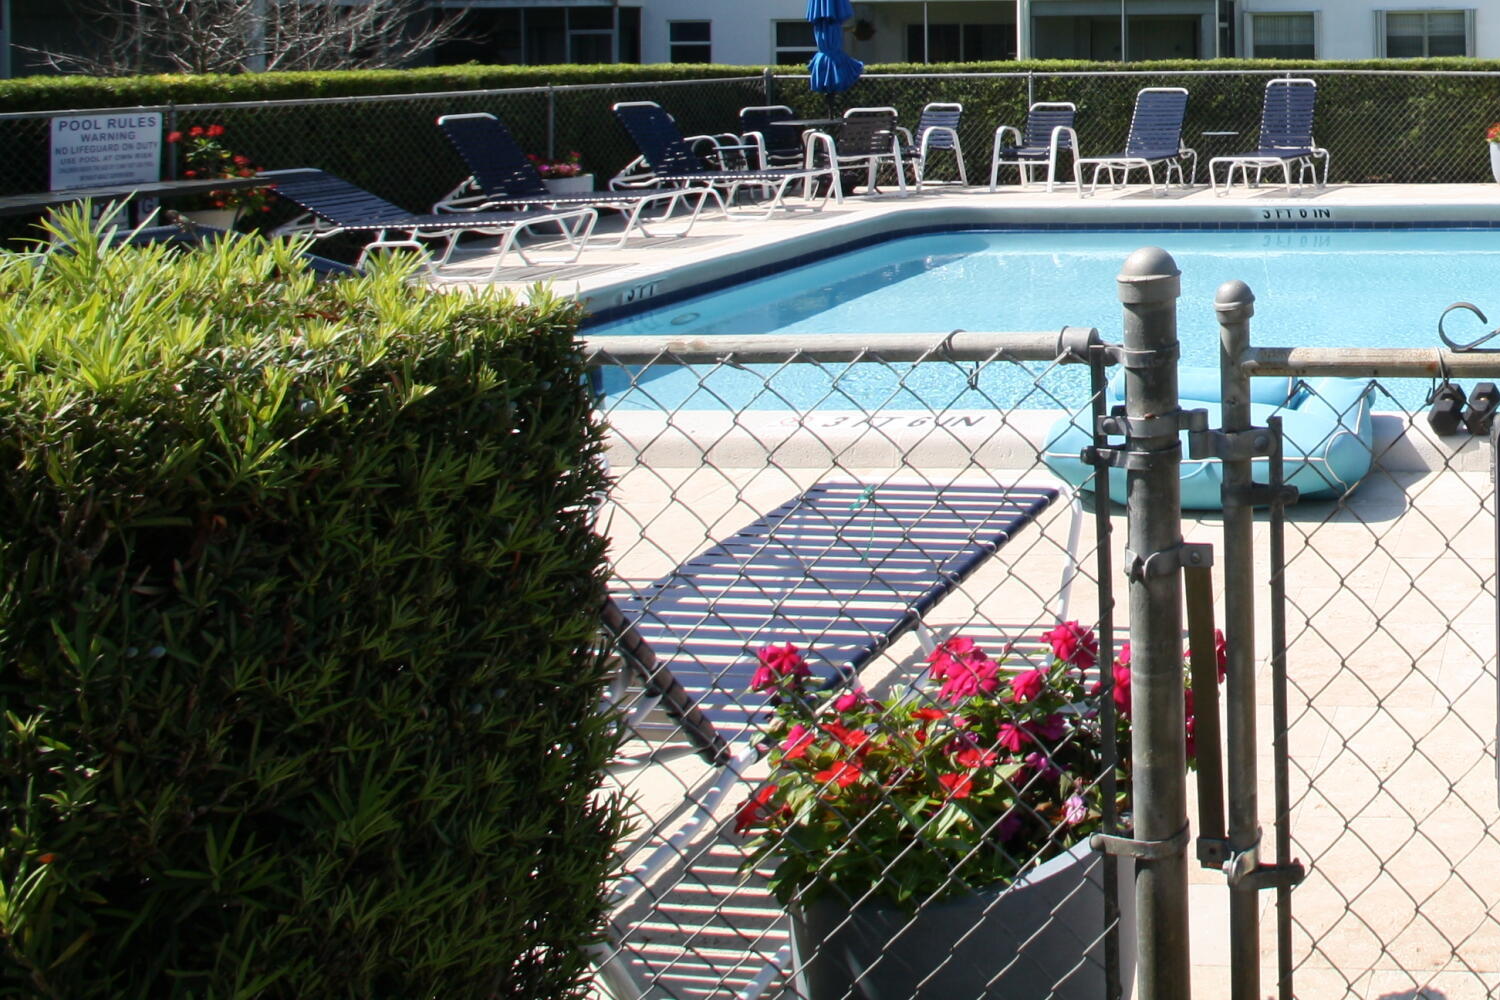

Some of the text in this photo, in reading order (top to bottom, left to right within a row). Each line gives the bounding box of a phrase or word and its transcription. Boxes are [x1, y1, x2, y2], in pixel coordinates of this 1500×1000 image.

[58, 117, 156, 131] POOL RULES
[81, 131, 136, 142] WARNING
[55, 147, 68, 155] NO
[70, 144, 119, 154] LIFEGUARD
[136, 142, 157, 150] DUTY
